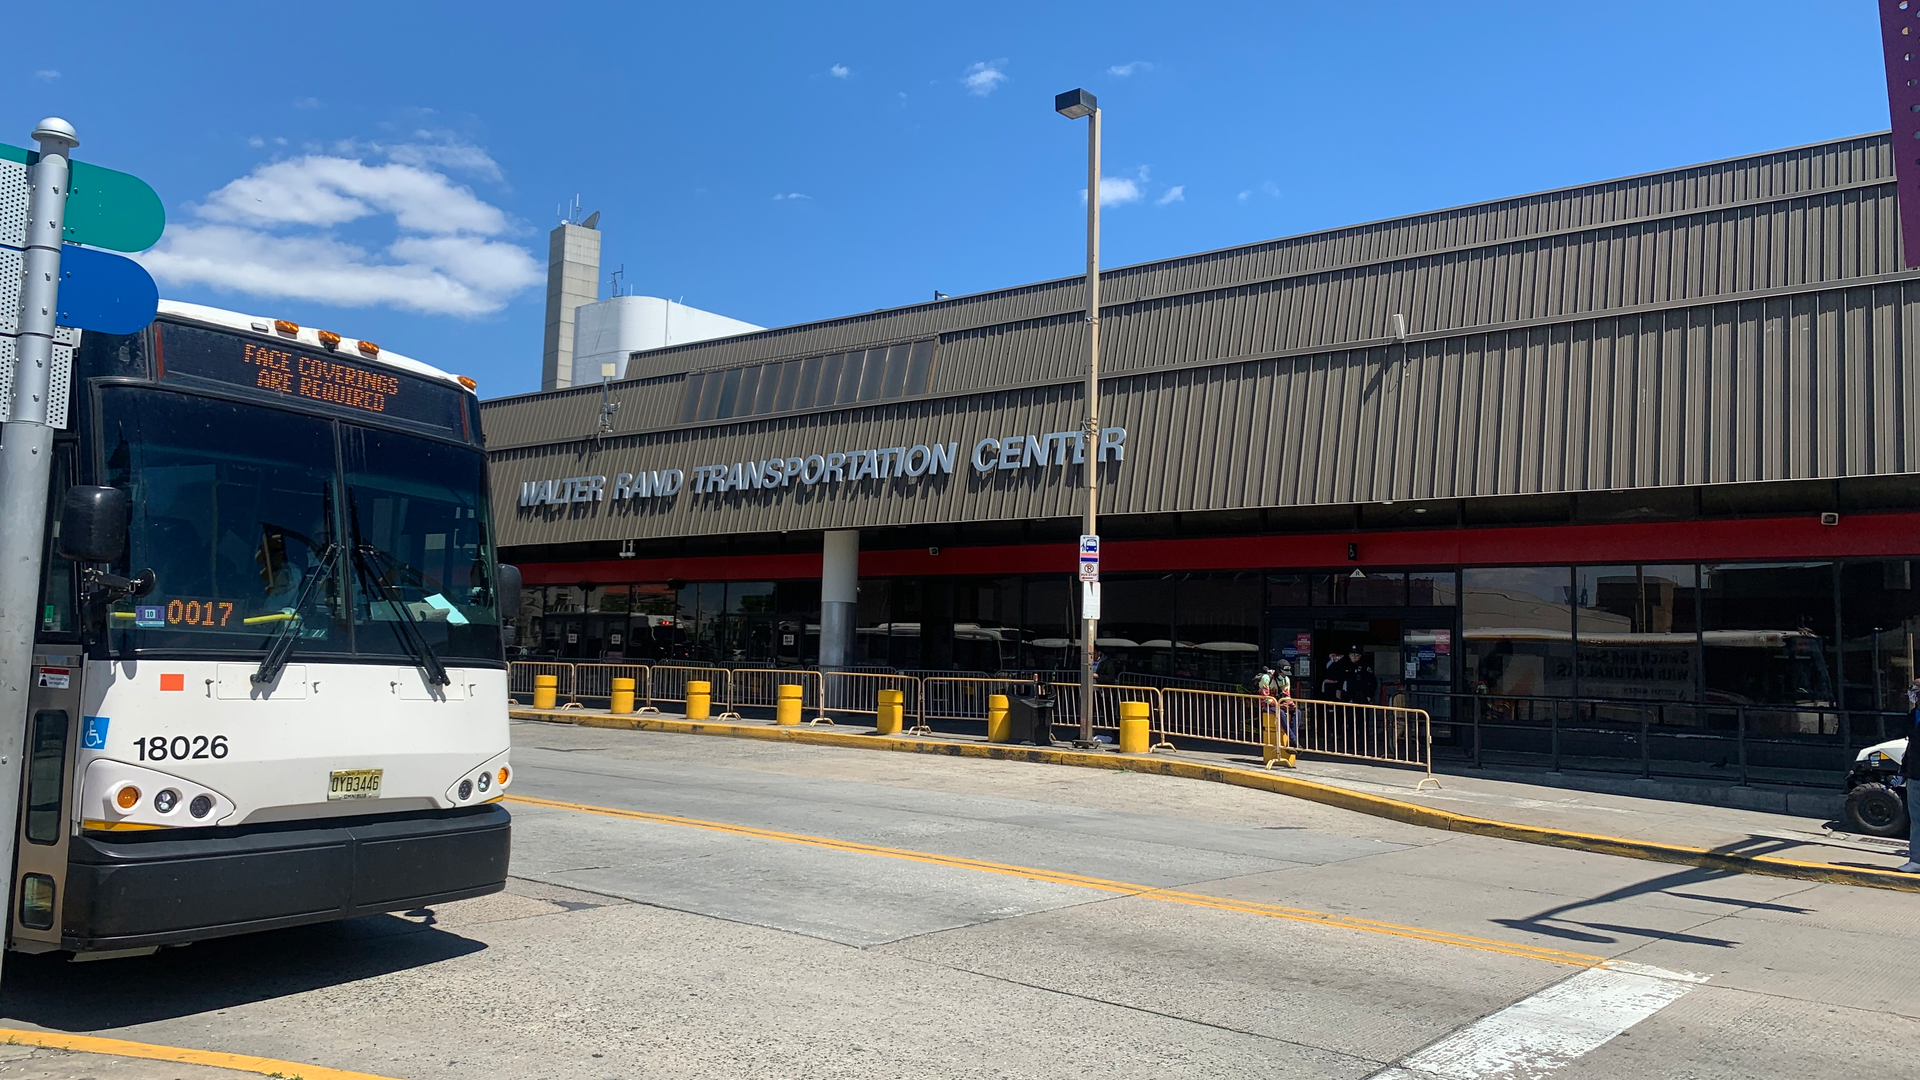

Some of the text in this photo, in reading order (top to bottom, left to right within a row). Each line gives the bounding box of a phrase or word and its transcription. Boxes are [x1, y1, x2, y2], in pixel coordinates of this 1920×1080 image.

[244, 344, 399, 395] FACE COVERINGS
[257, 369, 385, 412] ARE REQUIRED
[520, 475, 606, 507] WALTER
[612, 469, 684, 500] RAND
[693, 442, 957, 495] TRANSPORTATION
[146, 610, 154, 618] 10
[167, 599, 233, 627] 0017
[133, 735, 229, 761] 18026
